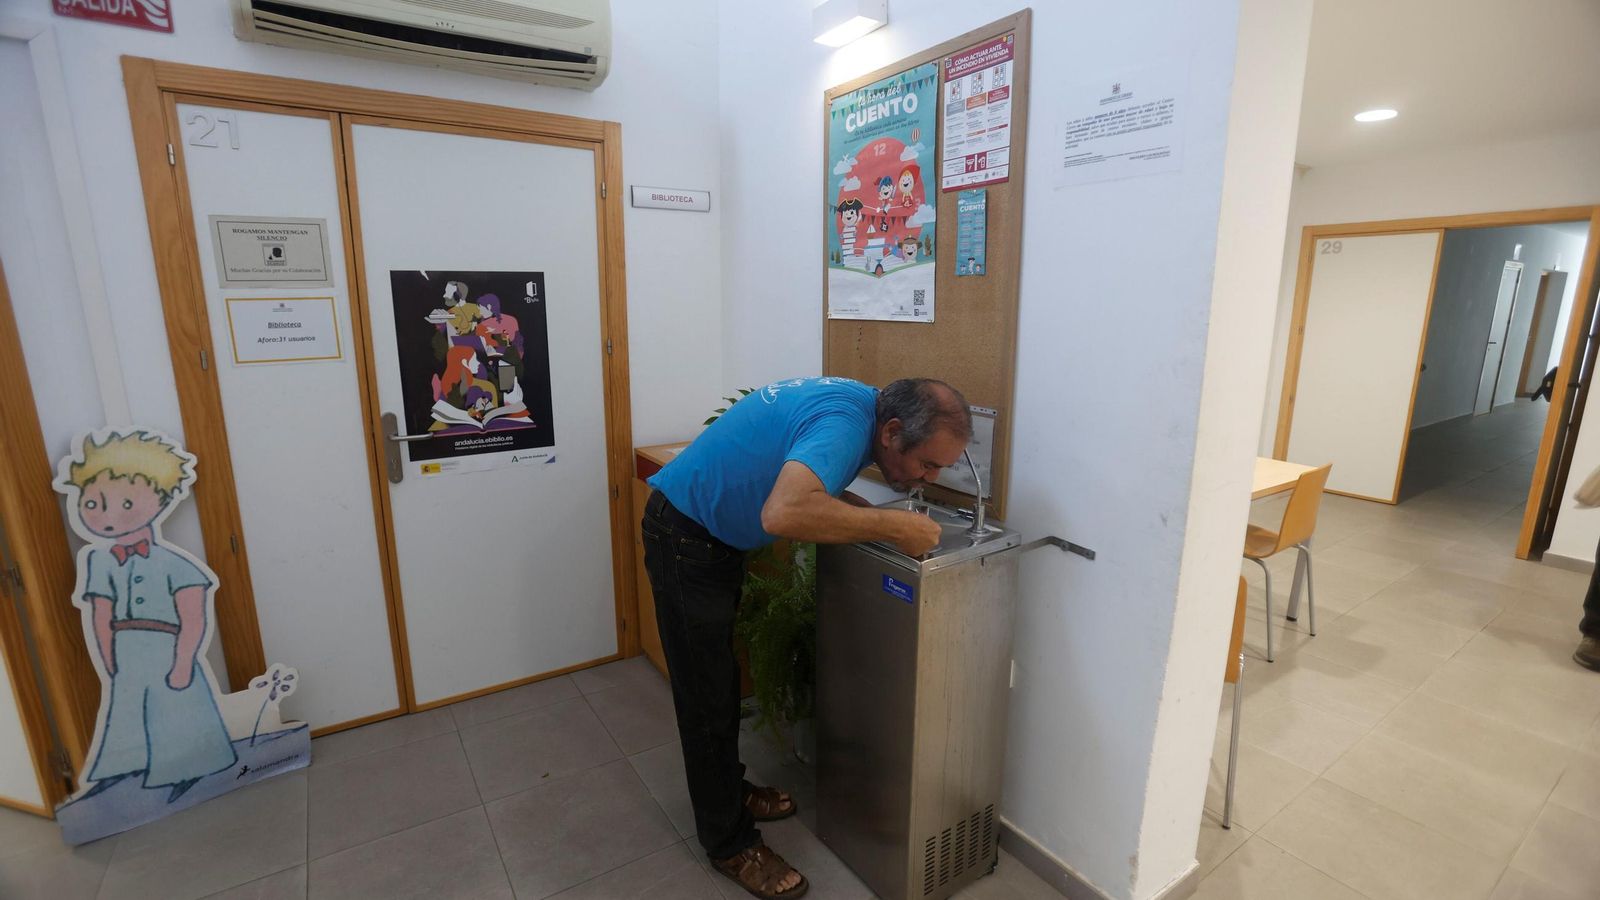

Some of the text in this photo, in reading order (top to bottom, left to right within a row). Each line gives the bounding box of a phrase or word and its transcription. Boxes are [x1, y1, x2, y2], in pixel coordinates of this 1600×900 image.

[970, 49, 988, 61] ACTUAR
[989, 43, 1003, 53] ANTE
[956, 59, 978, 72] INCENDIO
[985, 48, 1009, 61] VIVIENDA
[845, 92, 919, 133] CUENTO
[873, 142, 887, 157] 12
[651, 193, 694, 204] BIBLIOTECA
[959, 203, 986, 212] CUENTO
[1321, 240, 1343, 255] 29
[267, 321, 302, 329] Biblioteca
